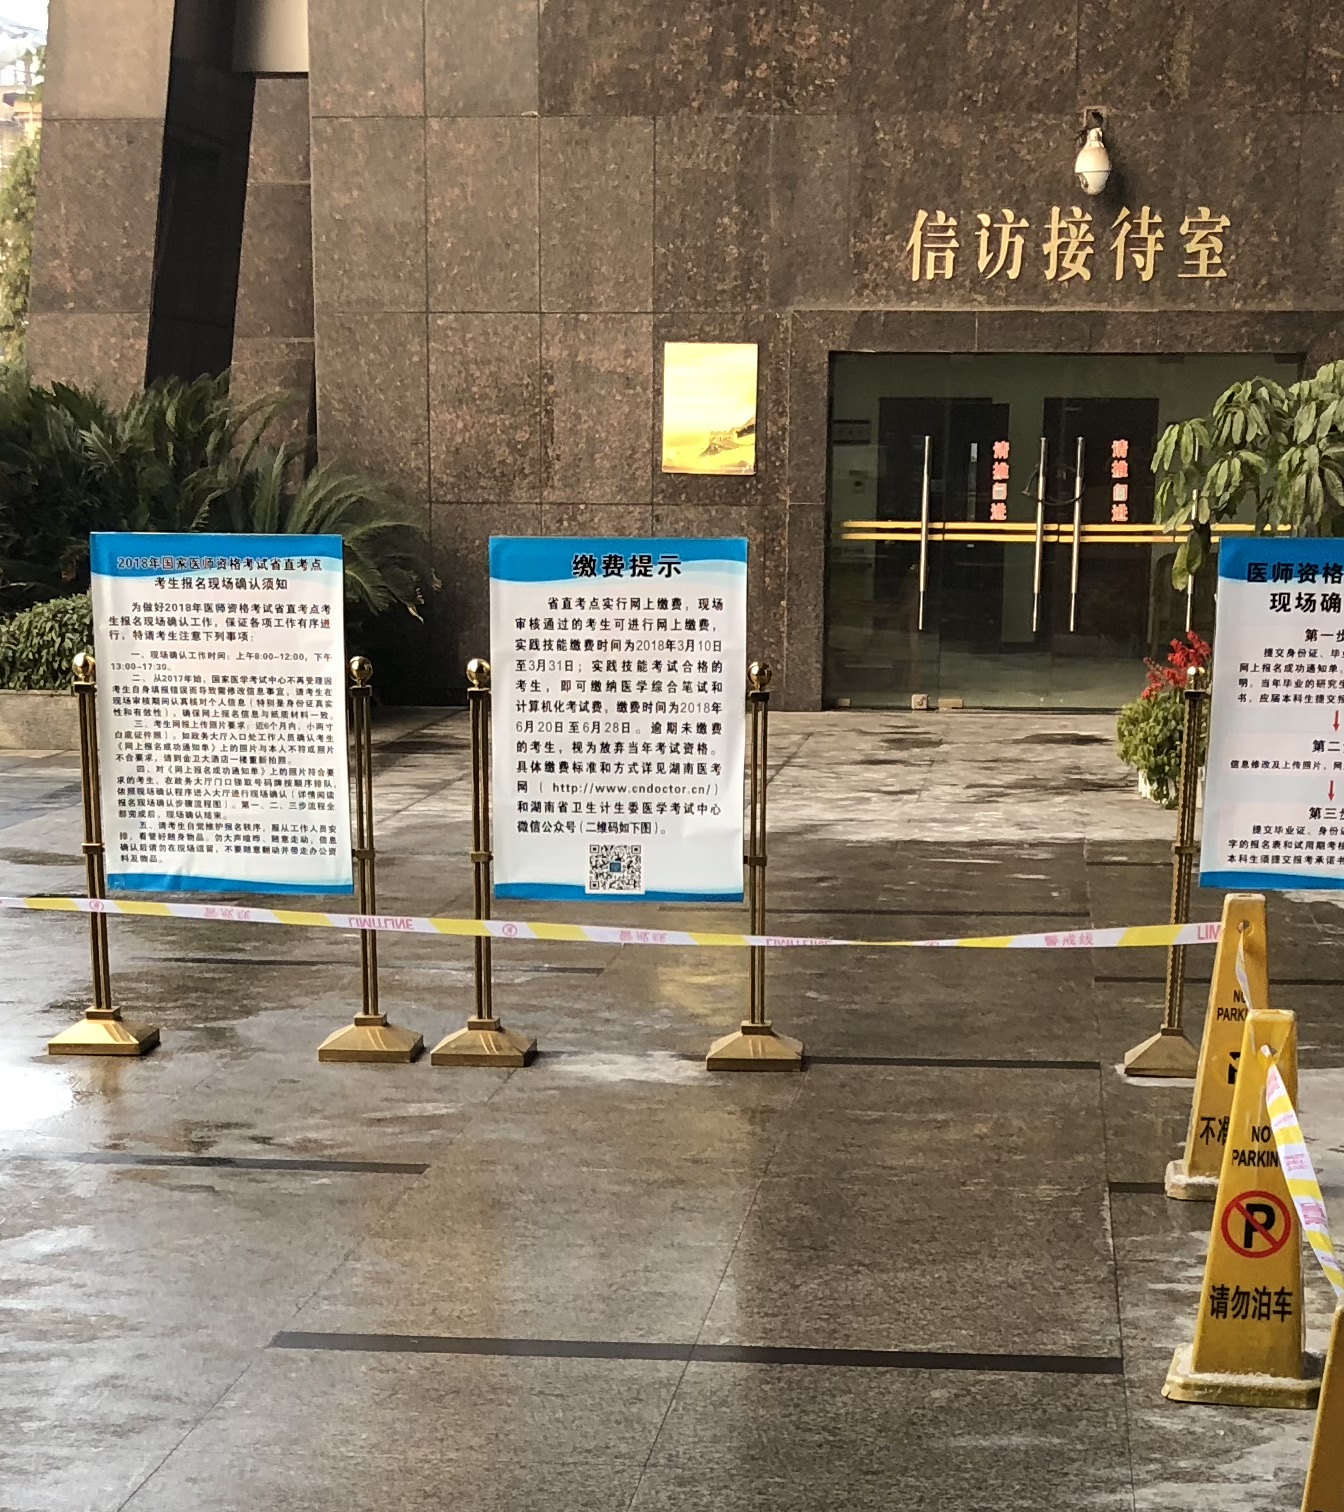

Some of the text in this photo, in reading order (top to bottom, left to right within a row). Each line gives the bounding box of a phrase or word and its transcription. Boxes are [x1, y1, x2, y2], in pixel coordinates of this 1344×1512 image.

[906, 205, 1232, 282] 信访接待室
[117, 555, 323, 573] 2018年国家医师资格考试省直考点
[573, 554, 682, 578] 缴费提示
[154, 577, 289, 591] 考生报名现场确认须知
[548, 597, 724, 611] 省直考点实行网上缴费，现场
[514, 618, 717, 632] 审核通过的考生可进行网上缴费，
[514, 639, 722, 653] 实践技能缴费时间为2018年3月10日
[516, 761, 722, 776] 具体缴费标准和方式详见湖南医考
[517, 801, 721, 816] 和湖南省卫生计生委医学考试中心
[1251, 1125, 1272, 1143] NO
[1232, 1149, 1282, 1169] PARKIN
[1209, 1285, 1294, 1323] 请勿泊车
